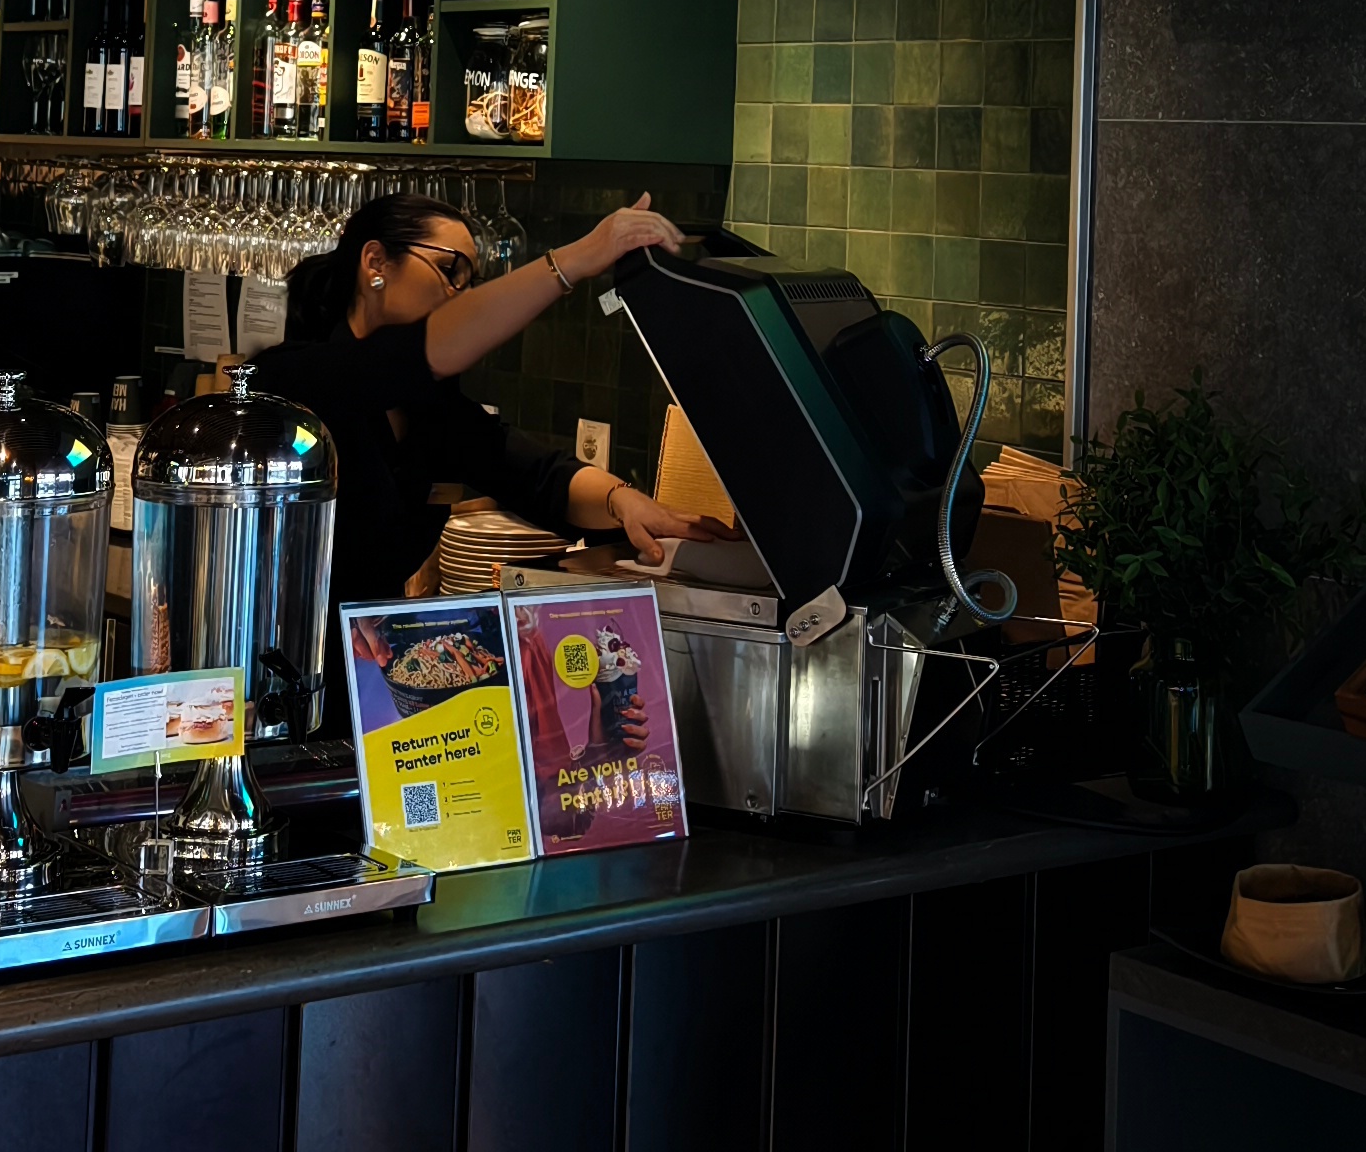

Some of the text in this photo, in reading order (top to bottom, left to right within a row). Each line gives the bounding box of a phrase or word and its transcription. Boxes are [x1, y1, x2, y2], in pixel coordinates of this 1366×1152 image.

[391, 728, 471, 754] Return your
[395, 741, 481, 773] Panter here!
[557, 757, 638, 786] Are you a
[313, 897, 353, 914] SUNNEX
[74, 933, 117, 949] SUNNEX
